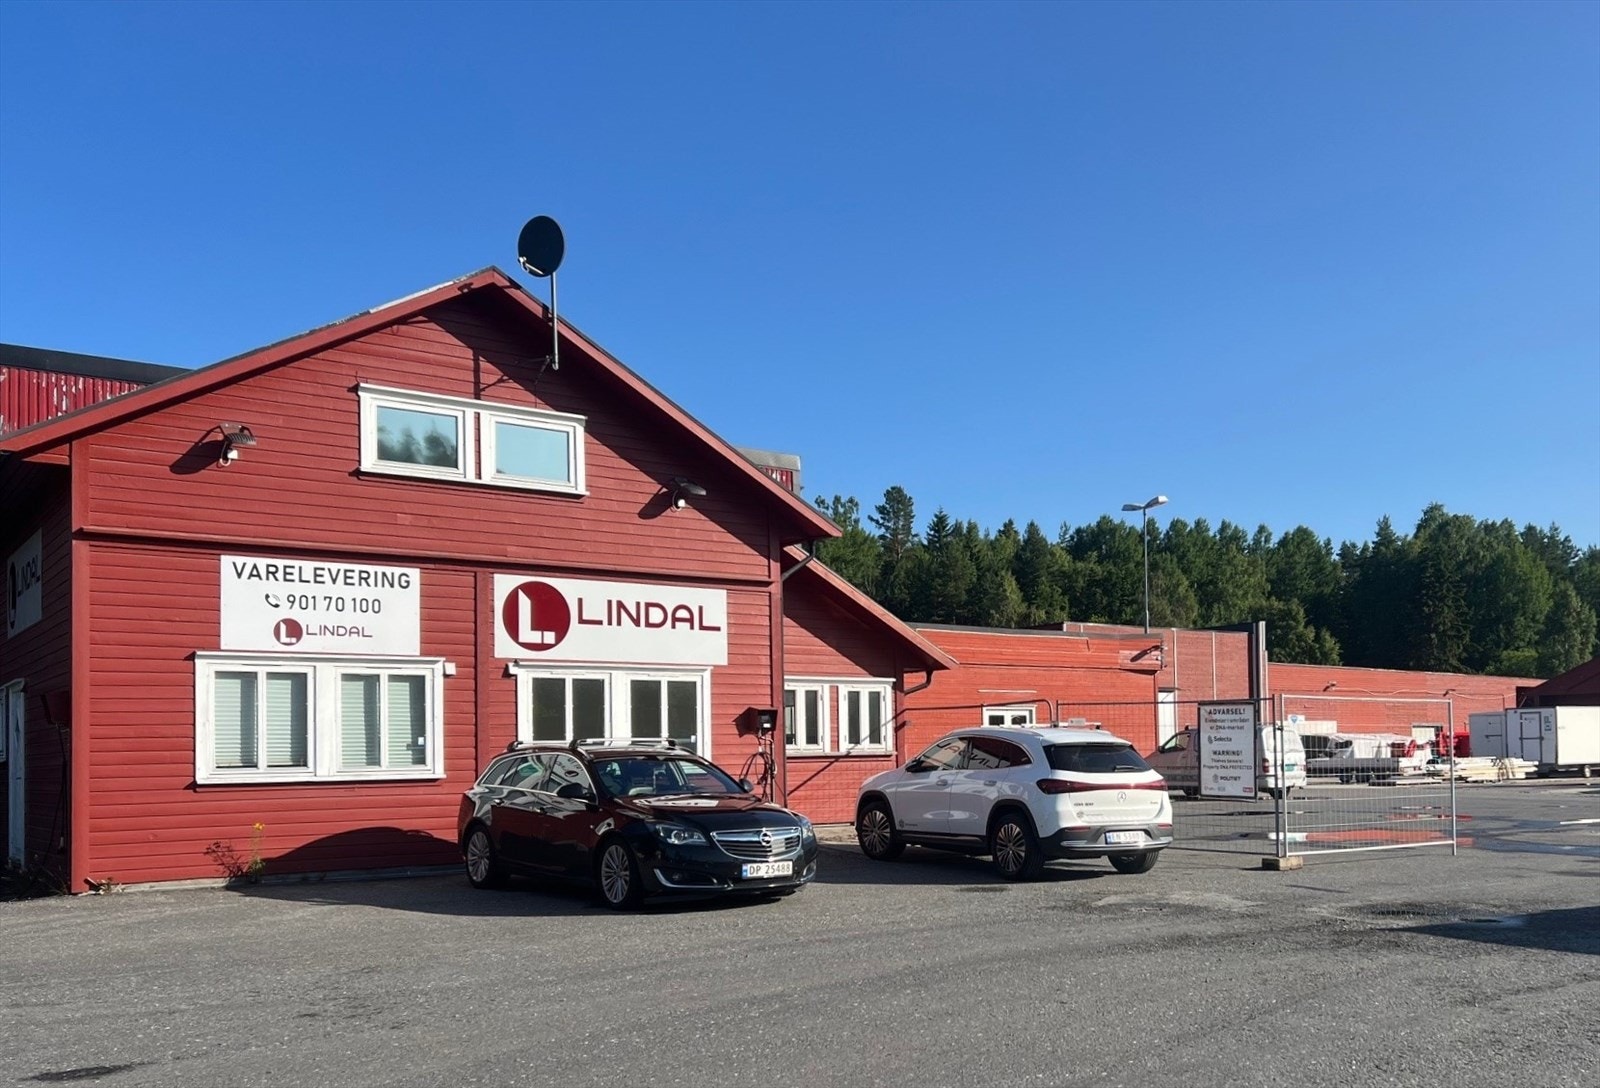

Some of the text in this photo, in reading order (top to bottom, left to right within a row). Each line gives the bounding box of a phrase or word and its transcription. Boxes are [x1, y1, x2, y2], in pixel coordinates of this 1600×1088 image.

[232, 561, 411, 589] VARELEVERING
[286, 594, 381, 614] 901 70 100
[577, 597, 721, 632] LINDAL
[305, 624, 373, 638] LINDAL
[749, 863, 791, 875] DP 25488
